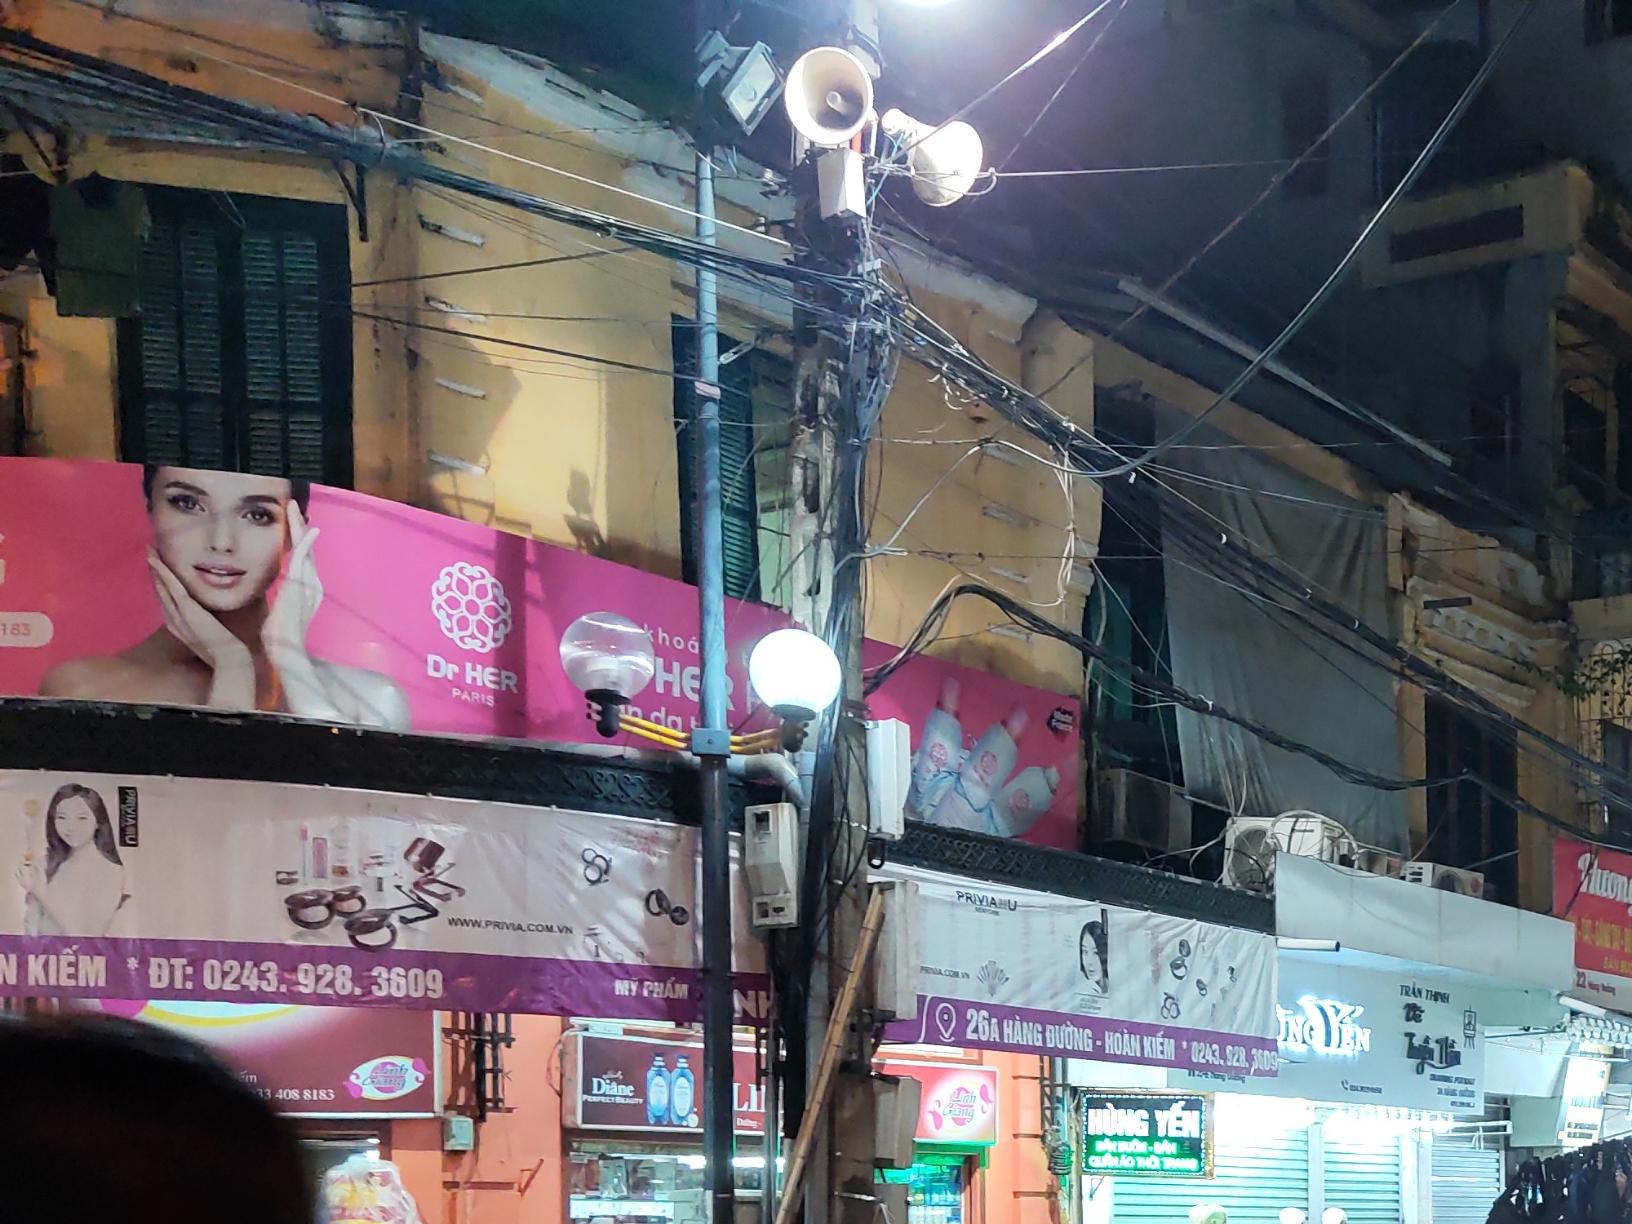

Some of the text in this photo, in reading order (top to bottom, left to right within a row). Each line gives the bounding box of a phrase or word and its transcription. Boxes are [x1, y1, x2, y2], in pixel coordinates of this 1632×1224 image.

[426, 655, 519, 694] Dr HER
[451, 687, 496, 708] PARIS
[956, 890, 999, 909] PRIVIA
[447, 916, 574, 936] WWW.PRIVIA.COM.VN
[27, 944, 108, 988] KIẾM
[148, 957, 194, 990] ĐT:
[202, 959, 288, 993] 0243.
[296, 963, 363, 996] 928.
[371, 966, 444, 999] 3609
[966, 1008, 1001, 1043] 26A
[1003, 1015, 1042, 1048] HÀNG
[1045, 1020, 1093, 1052] ĐƯỜNG
[1104, 1028, 1141, 1058] HOÀN
[1143, 1031, 1175, 1061] KIẾM
[275, 1089, 300, 1101] 408
[303, 1089, 335, 1101] 8183
[1087, 1101, 1200, 1138] HÙNG YẾN
